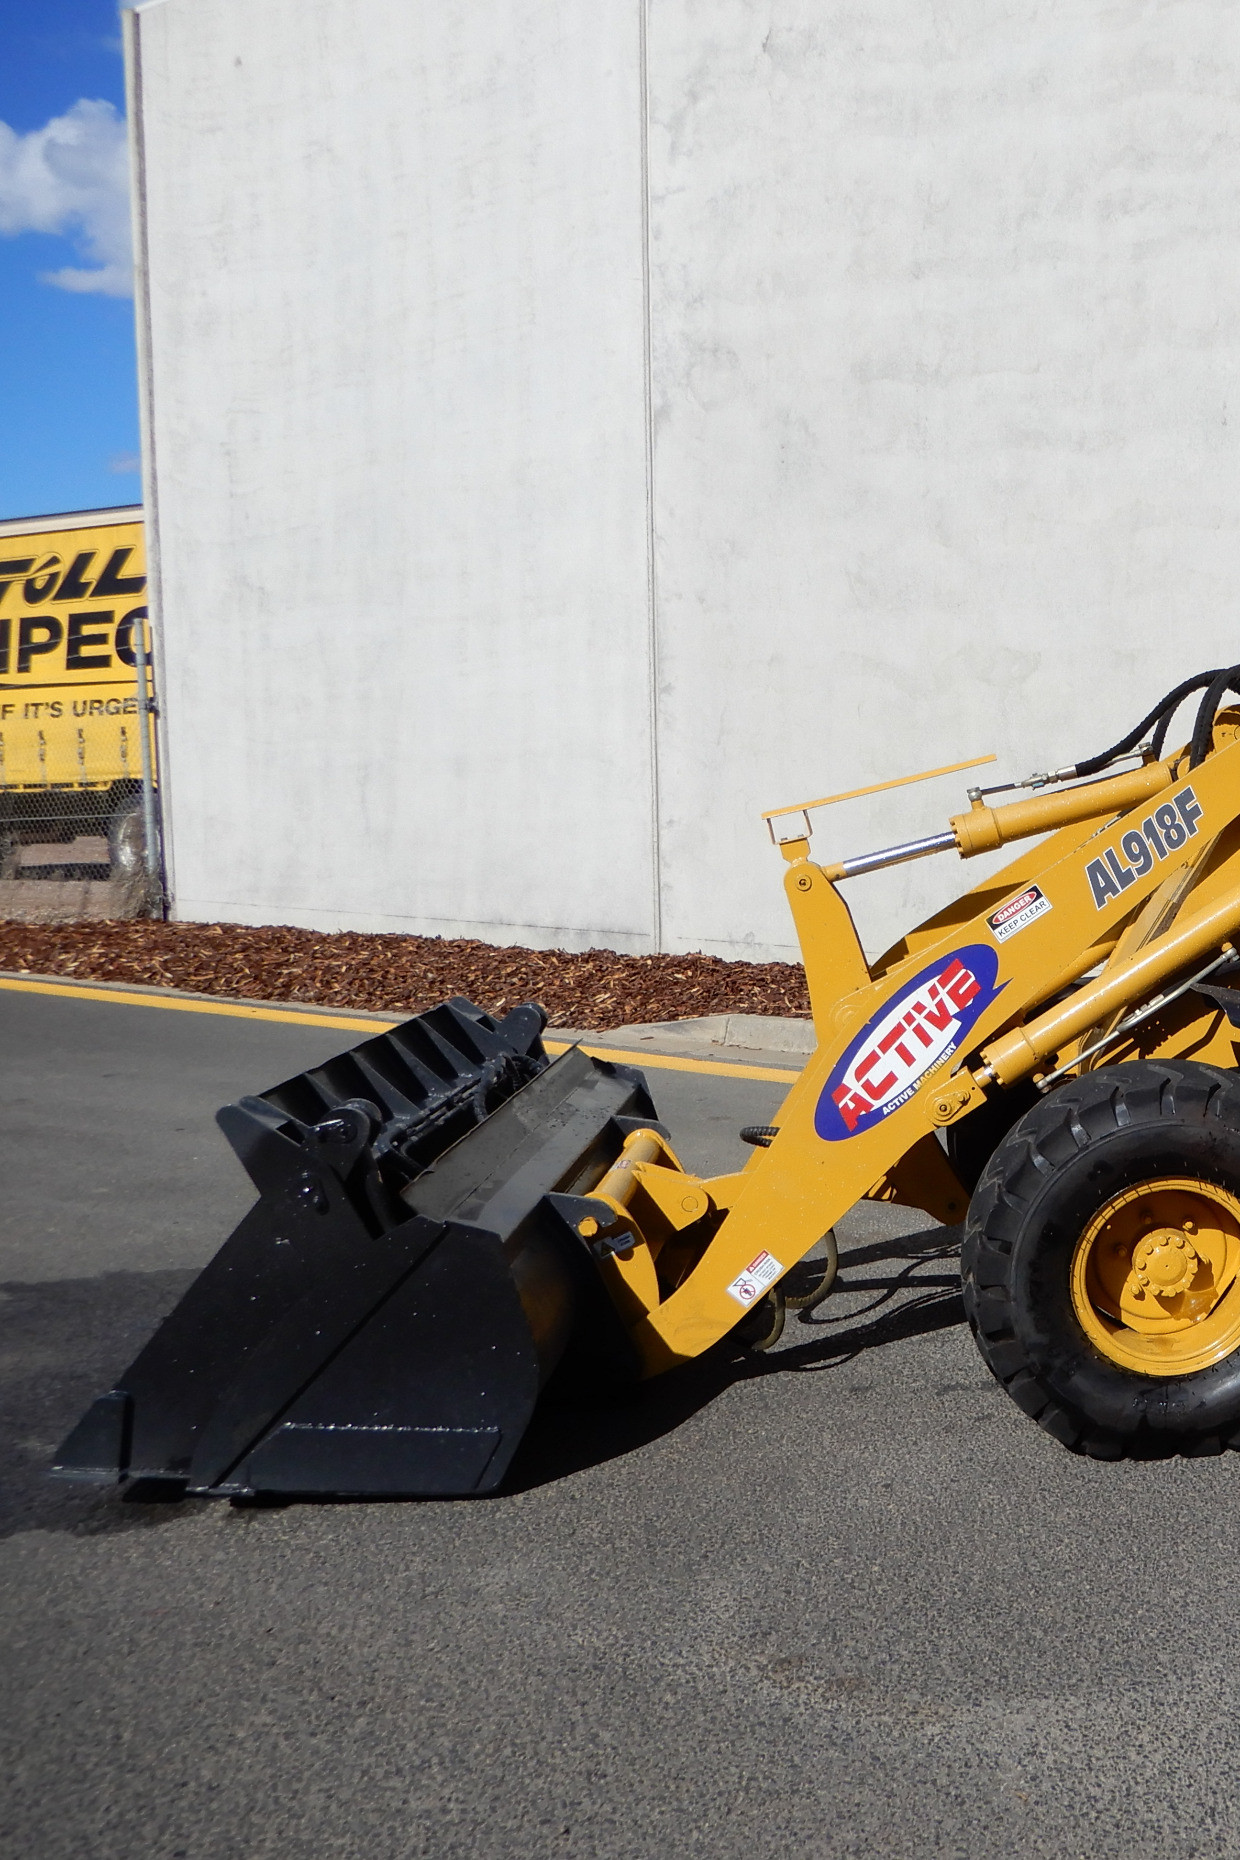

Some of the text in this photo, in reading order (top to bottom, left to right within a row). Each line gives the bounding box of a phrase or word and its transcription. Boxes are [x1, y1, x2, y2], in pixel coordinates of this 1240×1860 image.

[25, 701, 63, 718] IT'S
[1085, 785, 1204, 911] AL918F
[997, 895, 1032, 922] DANGER
[998, 900, 1046, 937] KEEP CLEAR
[831, 958, 982, 1132] ACTIVE
[882, 1041, 957, 1115] ACTIVE MACHINERY
